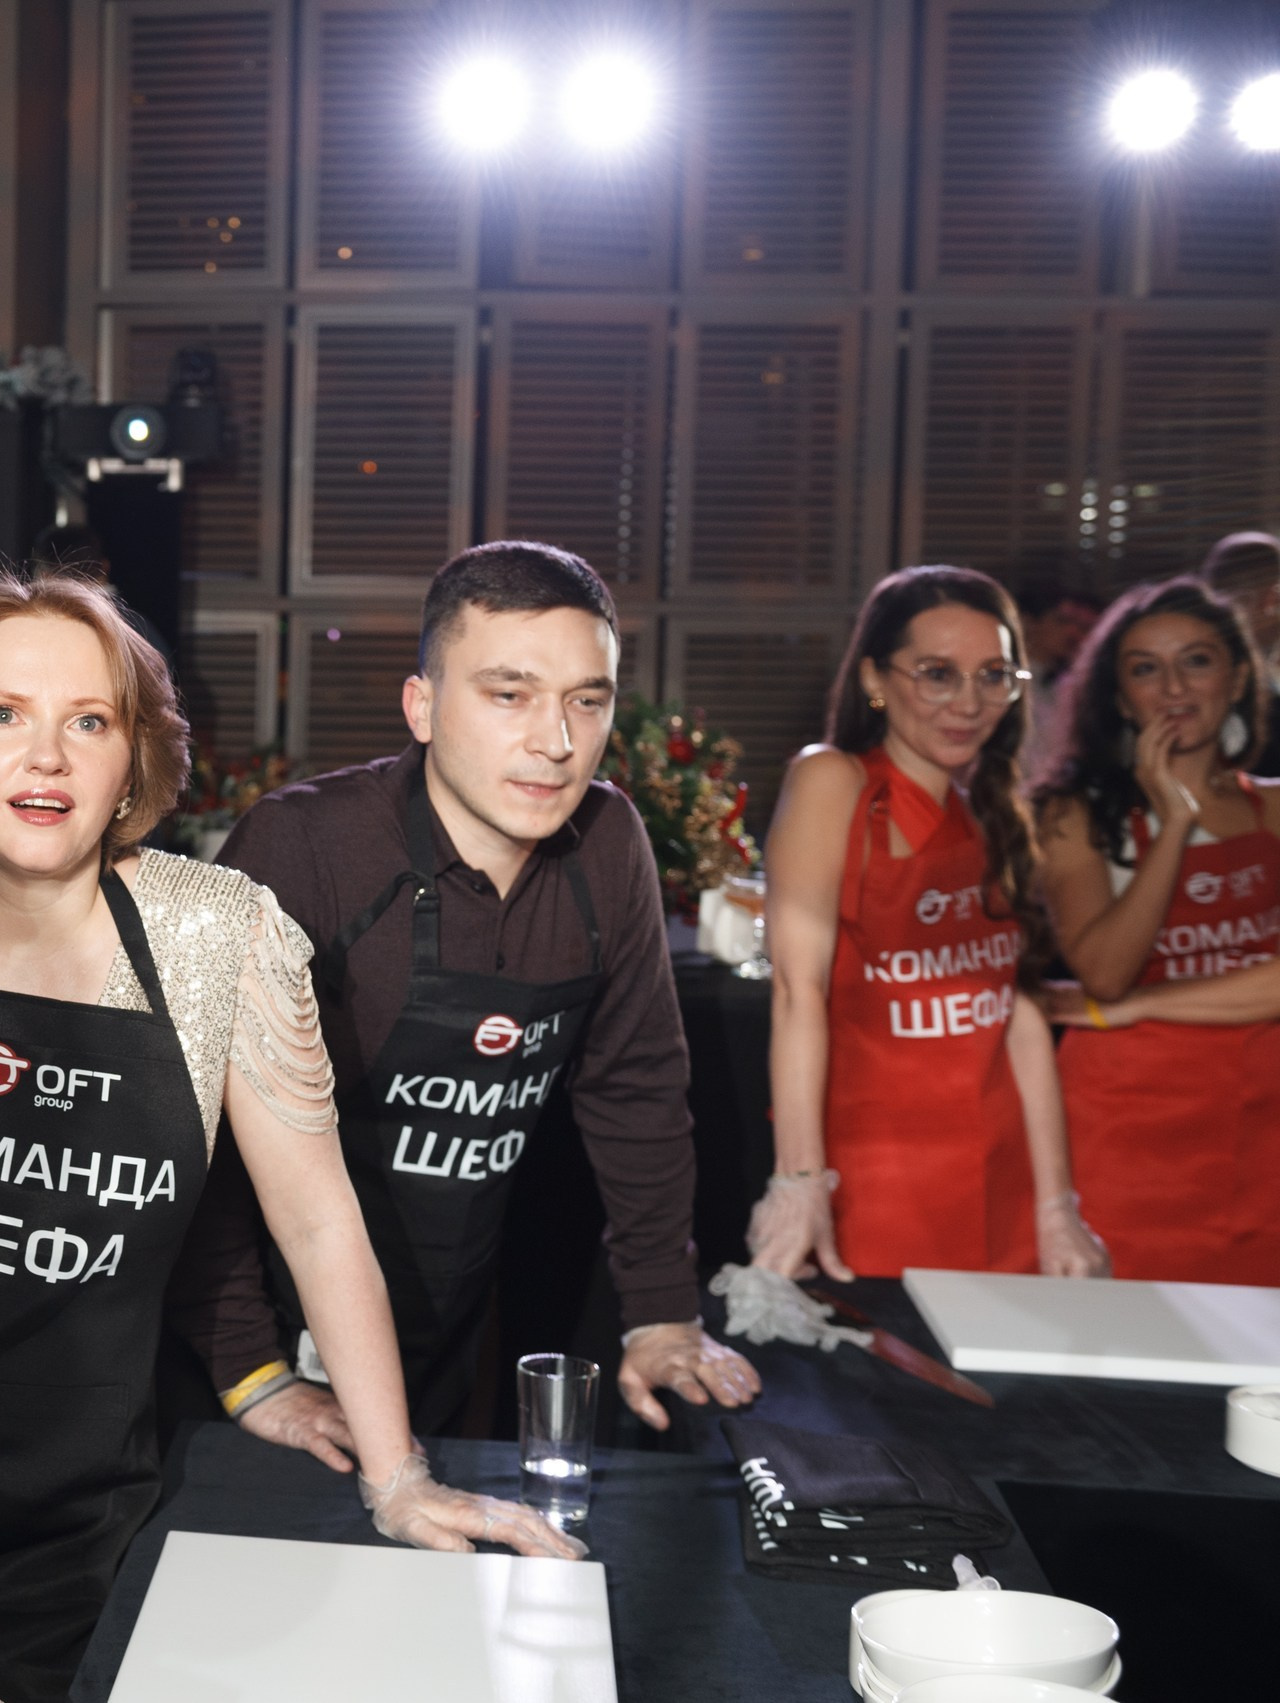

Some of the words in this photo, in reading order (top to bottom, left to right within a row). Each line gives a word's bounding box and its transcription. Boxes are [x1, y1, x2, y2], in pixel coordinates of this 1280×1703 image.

[35, 1064, 122, 1102] OFT
[33, 1094, 74, 1112] group
[392, 1129, 526, 1182] ШЕФ
